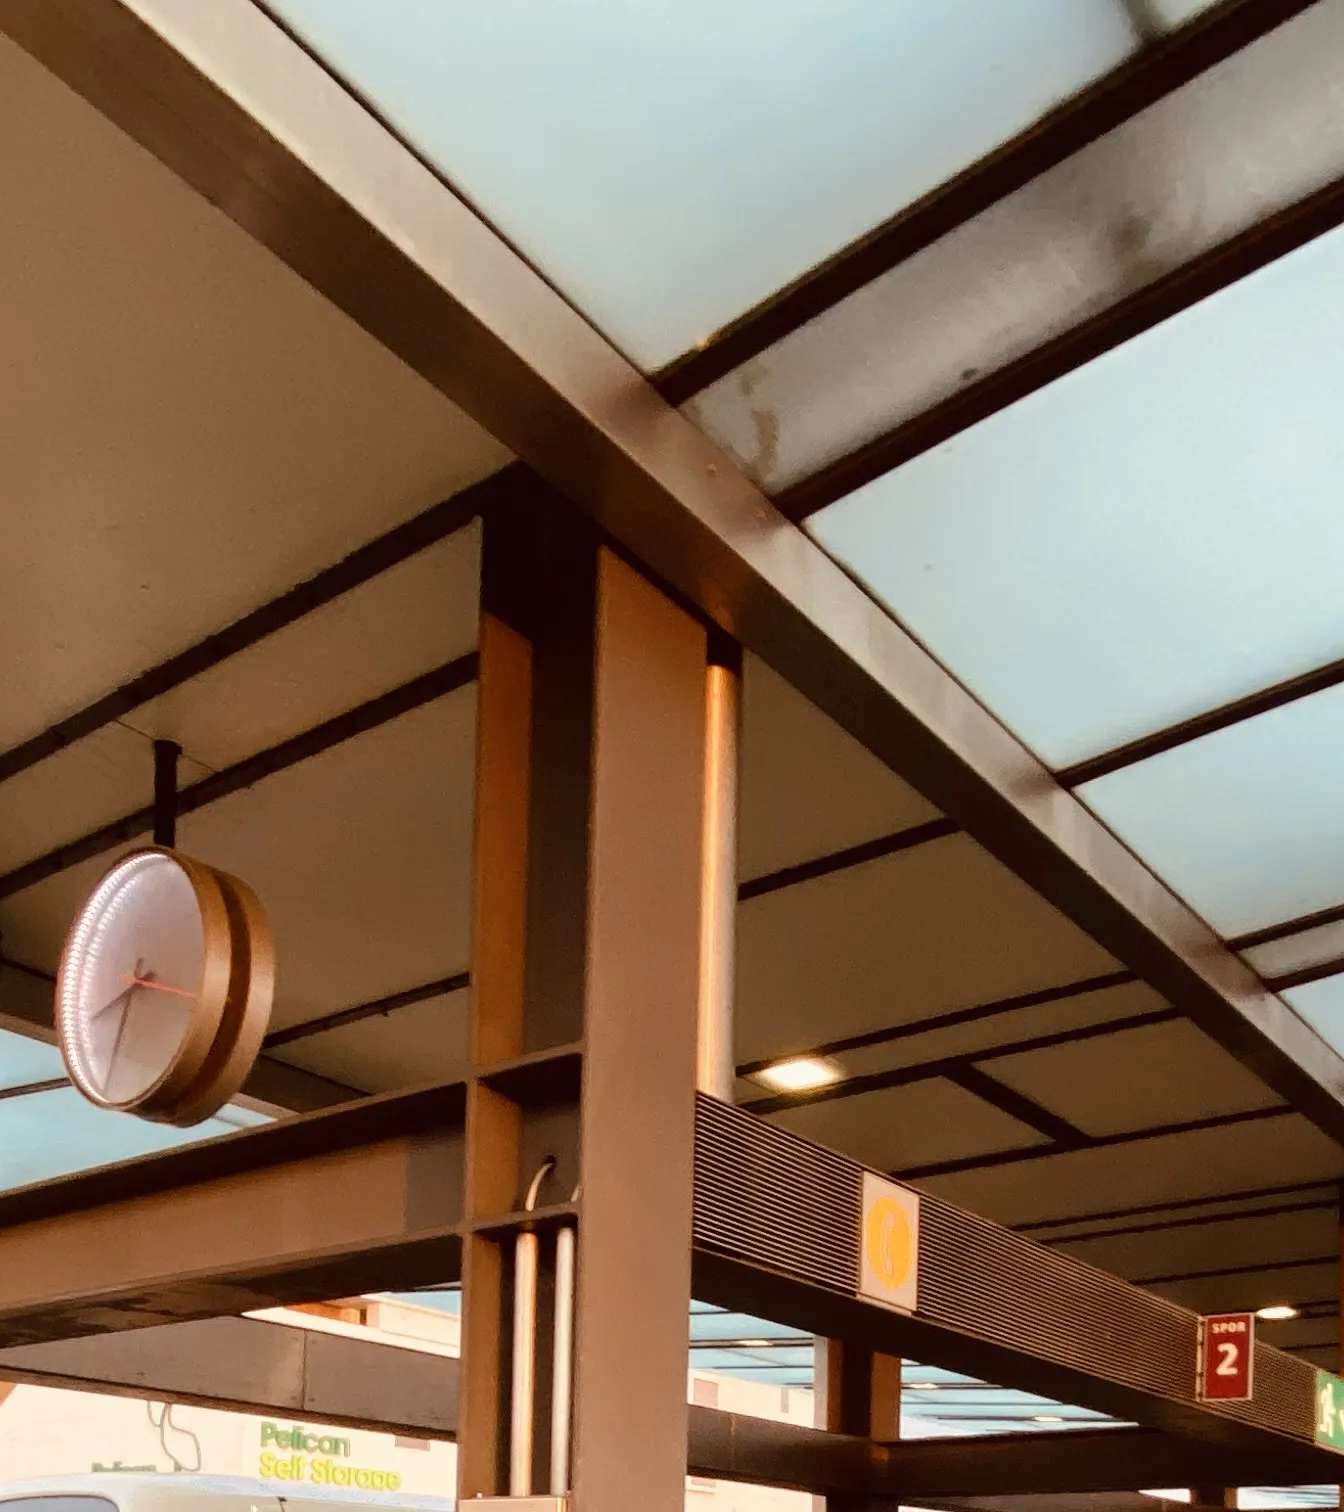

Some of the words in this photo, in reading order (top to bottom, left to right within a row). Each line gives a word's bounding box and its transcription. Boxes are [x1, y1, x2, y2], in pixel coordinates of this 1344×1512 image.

[1212, 1321, 1246, 1333] SPOR
[1216, 1342, 1238, 1376] 2
[260, 1421, 351, 1457] Pelican
[259, 1451, 305, 1480] Self
[310, 1457, 401, 1491] Storage
